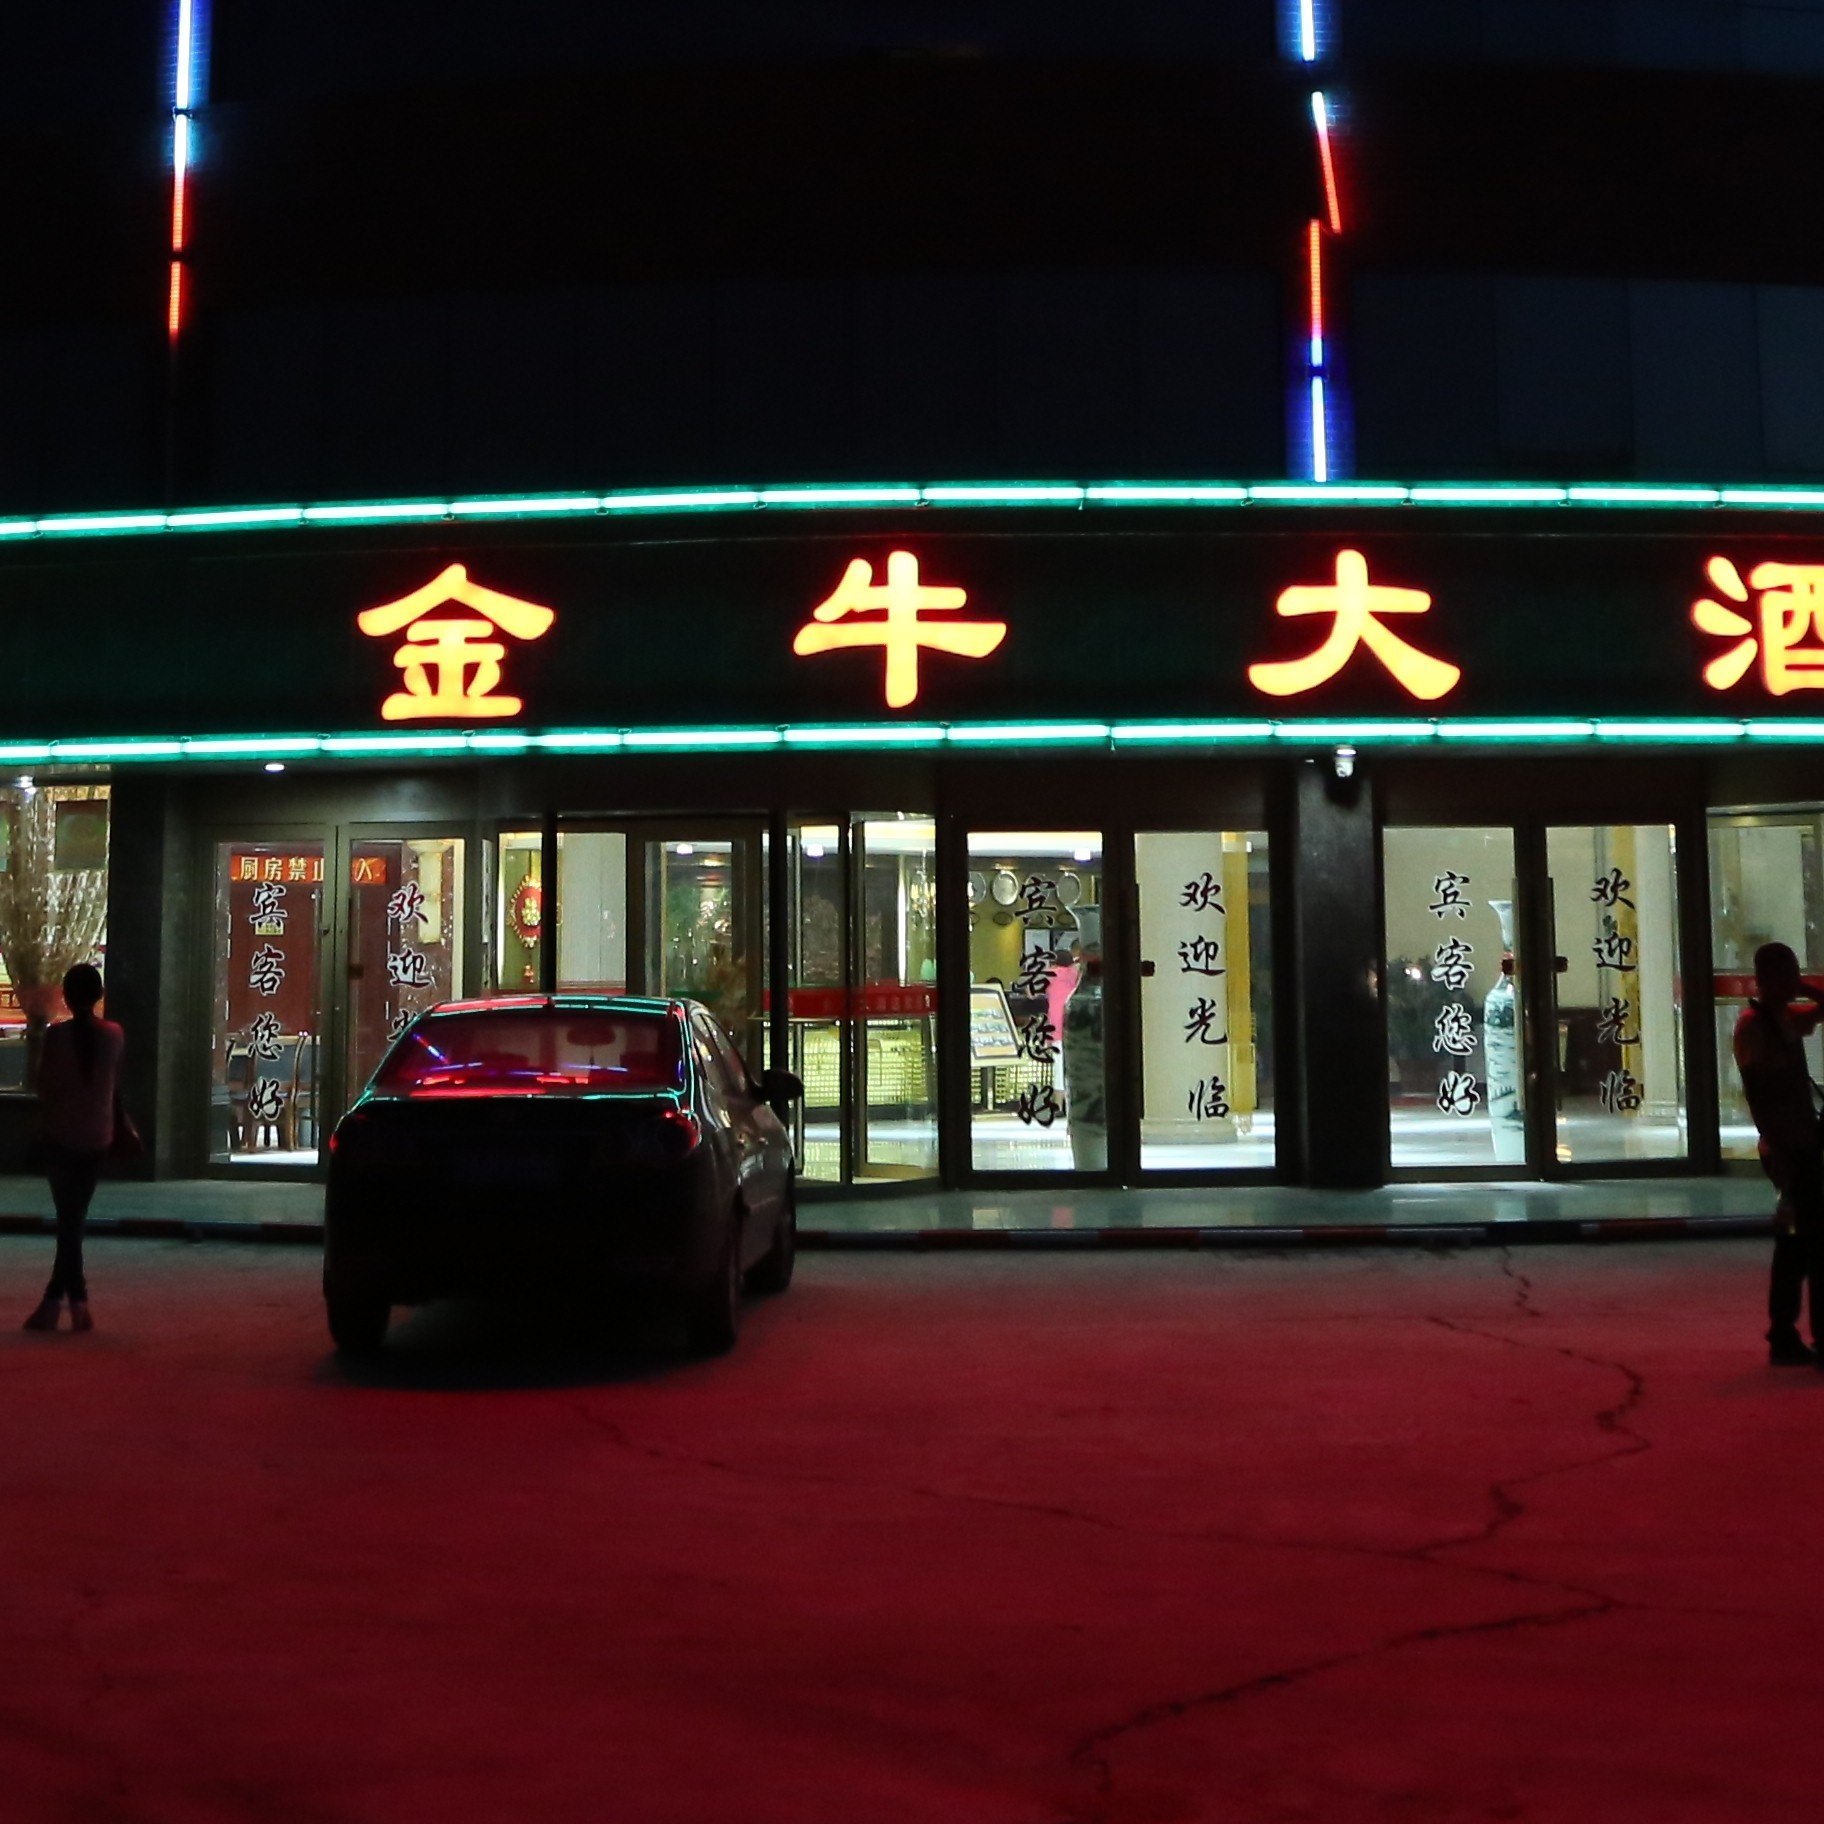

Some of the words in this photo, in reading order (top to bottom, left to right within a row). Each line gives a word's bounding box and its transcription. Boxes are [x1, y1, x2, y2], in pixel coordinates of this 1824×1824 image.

[247, 882, 288, 1121] 宾客您好
[1010, 875, 1061, 1129] 宾客您好
[1178, 871, 1229, 1123] 欢迎光临
[1428, 869, 1482, 1118] 宾客您好
[1590, 867, 1644, 1115] 欢迎光临
